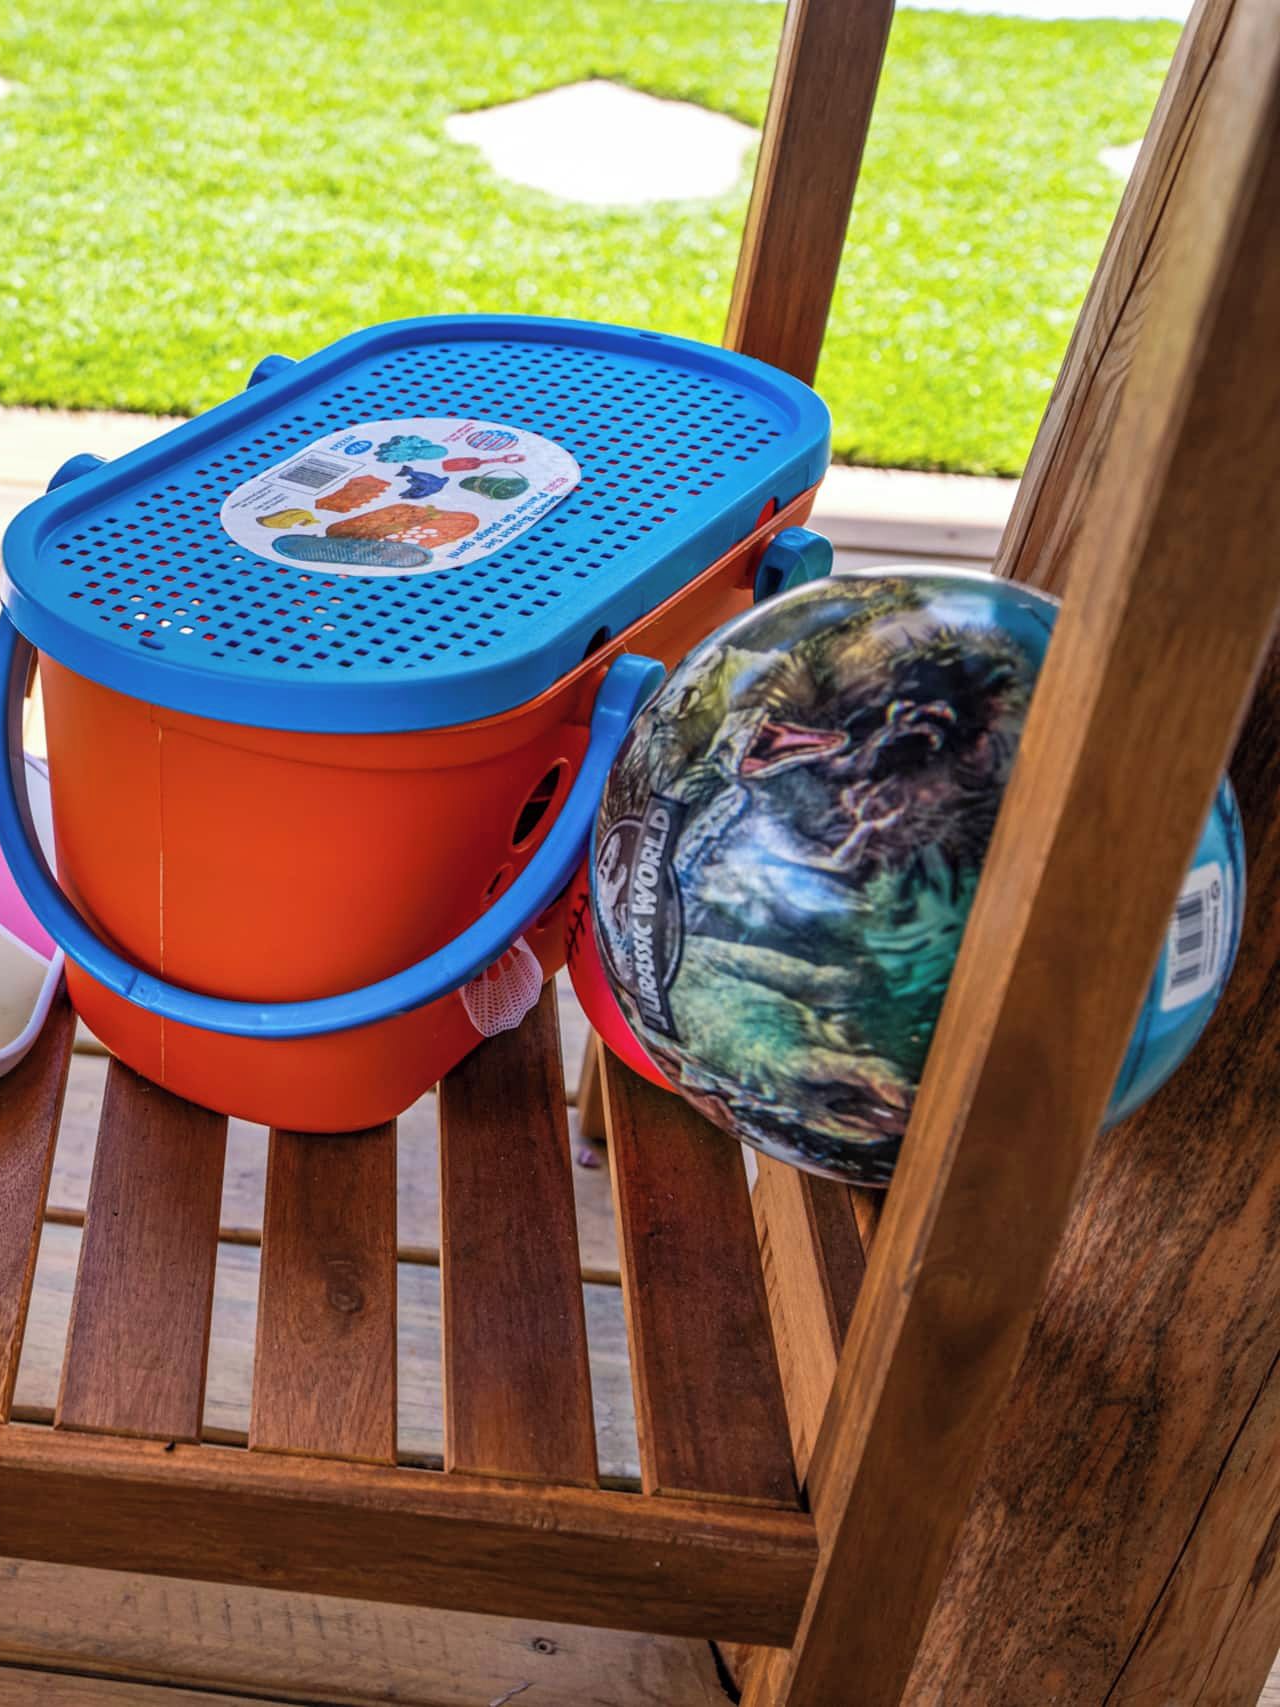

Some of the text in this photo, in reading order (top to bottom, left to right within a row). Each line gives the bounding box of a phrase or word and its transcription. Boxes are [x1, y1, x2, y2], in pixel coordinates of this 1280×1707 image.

[447, 492, 549, 559] Panier de plage garni
[480, 537, 504, 549] Set
[498, 515, 536, 538] Basket
[632, 807, 670, 1030] JURASSIC WORLD
